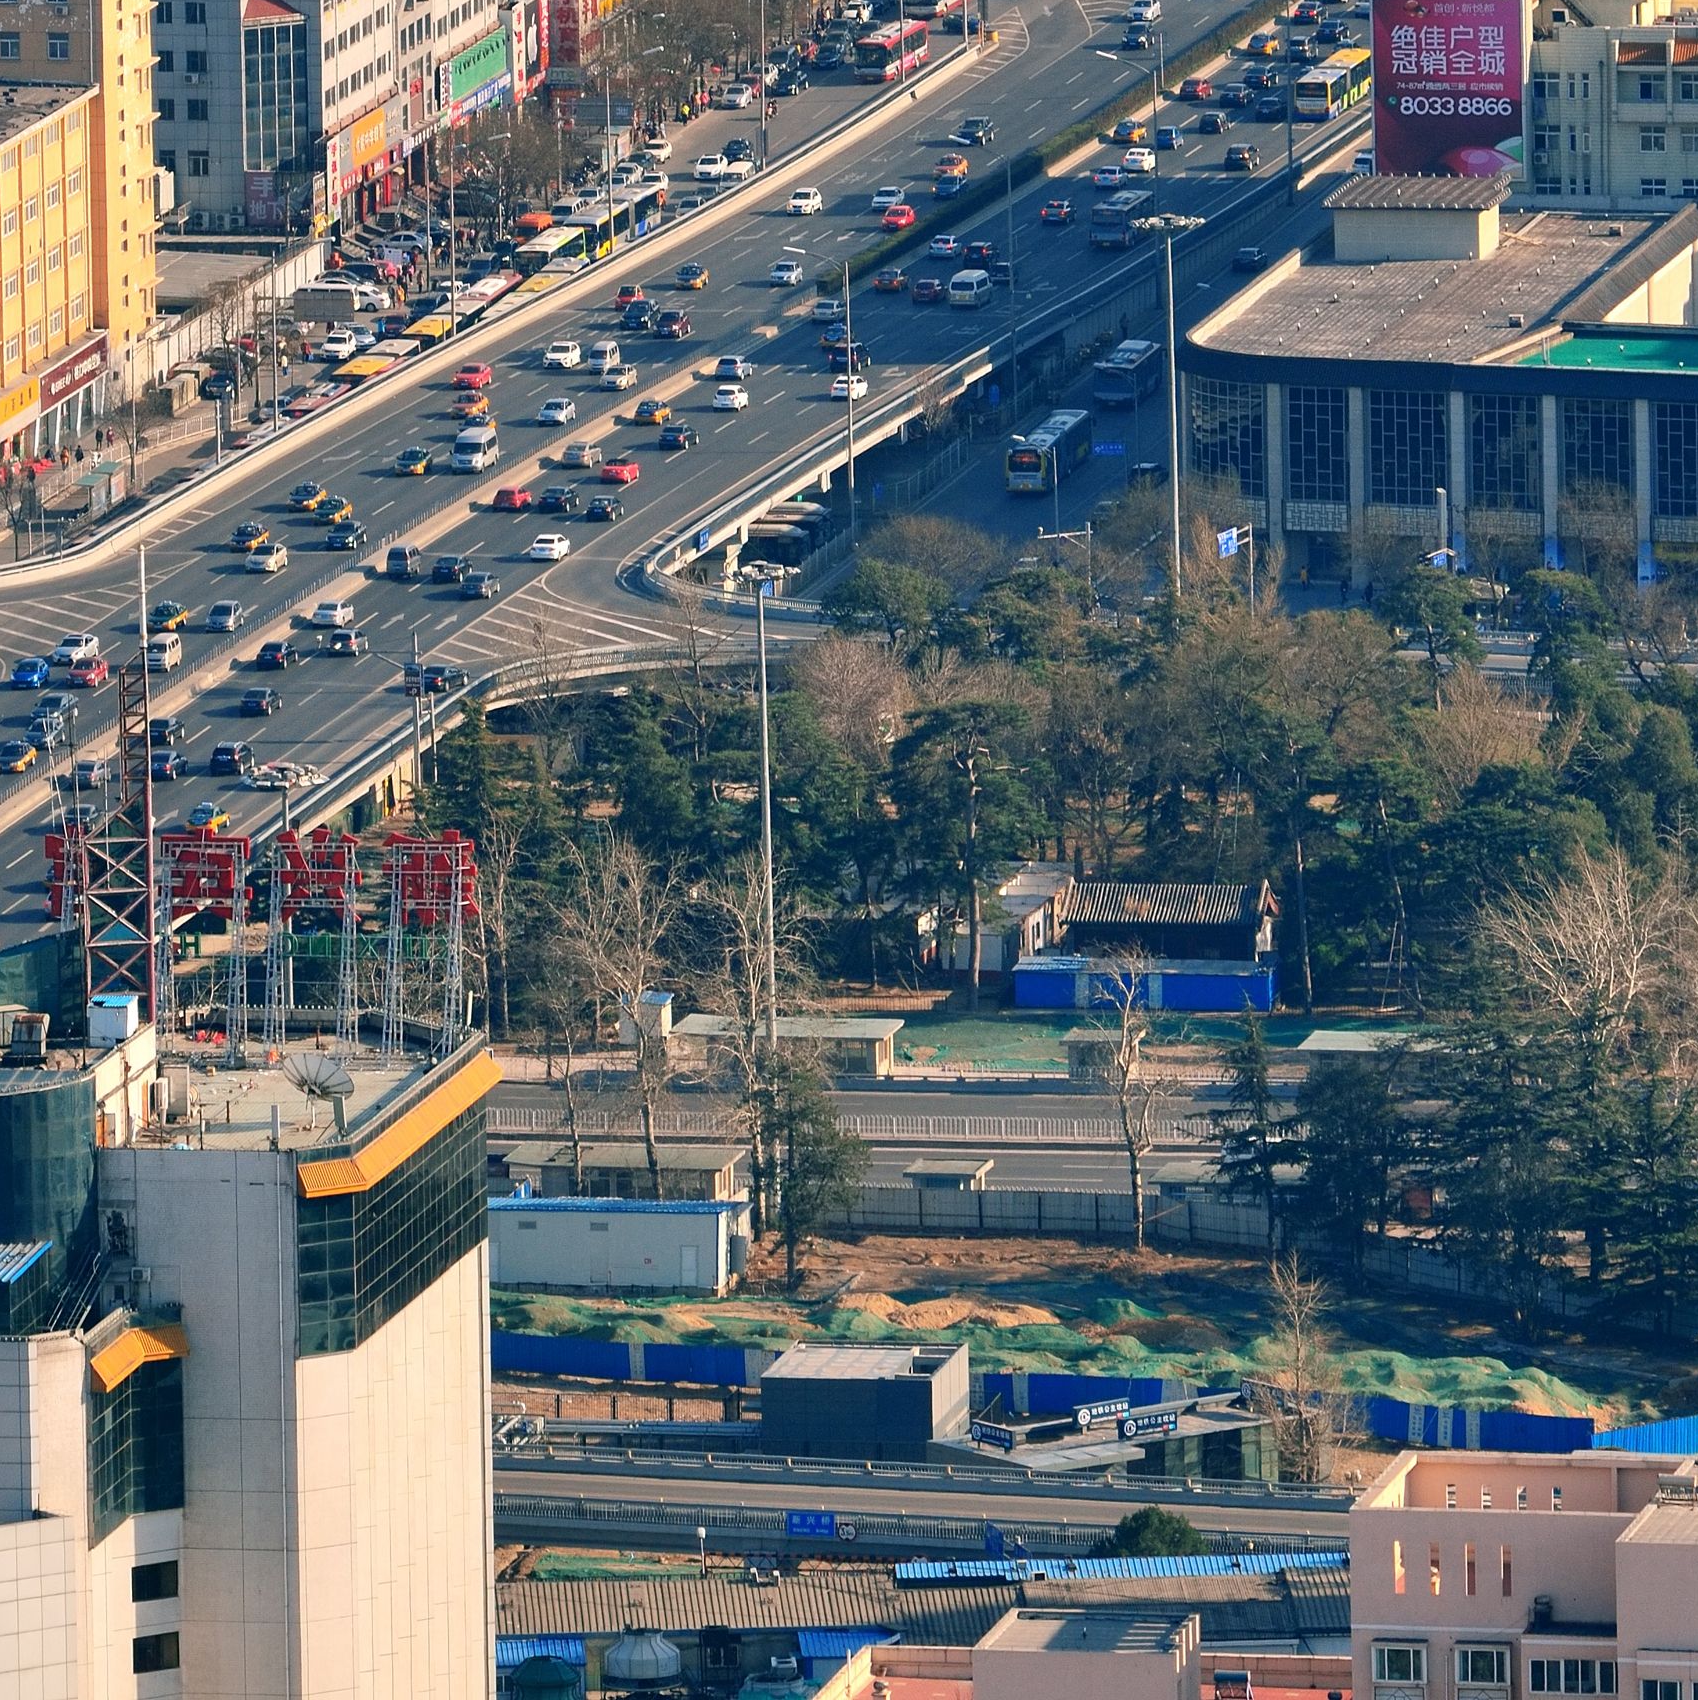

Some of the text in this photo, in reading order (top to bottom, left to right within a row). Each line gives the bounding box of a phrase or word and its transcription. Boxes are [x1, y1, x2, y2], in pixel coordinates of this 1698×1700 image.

[1391, 25, 1505, 50] 绝佳户型
[1392, 50, 1505, 76] 冠销全城
[1400, 96, 1512, 115] 8033 8866
[1091, 1401, 1129, 1416] 地铁公主坟站
[1136, 1414, 1176, 1428] 地铁公主坟站
